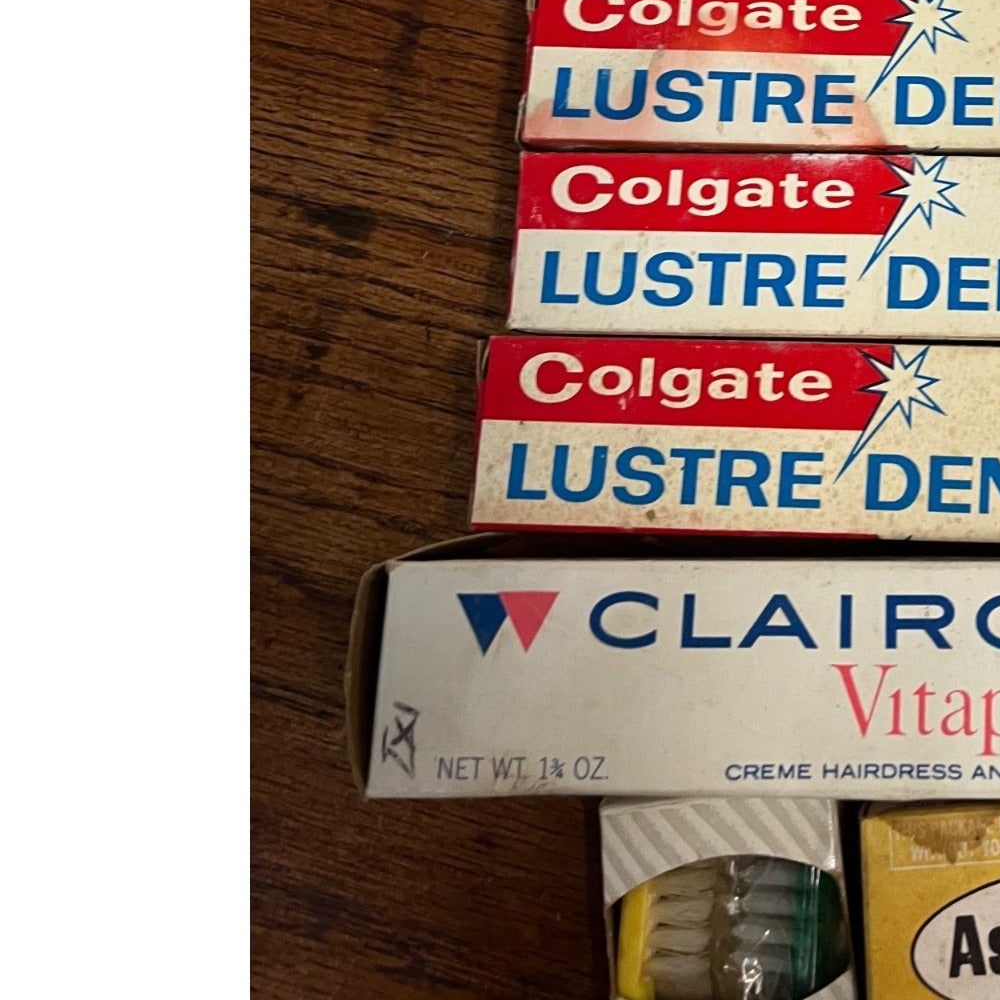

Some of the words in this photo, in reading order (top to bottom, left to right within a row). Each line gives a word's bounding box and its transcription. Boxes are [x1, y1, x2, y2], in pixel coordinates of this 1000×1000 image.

[551, 67, 856, 125] LUSTRE
[551, 164, 855, 217] Colgate
[540, 250, 847, 308] LUSTRE
[519, 351, 833, 409] Colgate
[506, 443, 824, 509] LUSTRE
[437, 757, 484, 779] NET
[573, 756, 609, 780] OZ.
[726, 763, 811, 780] CREME
[822, 763, 962, 781] HAIRDRESS
